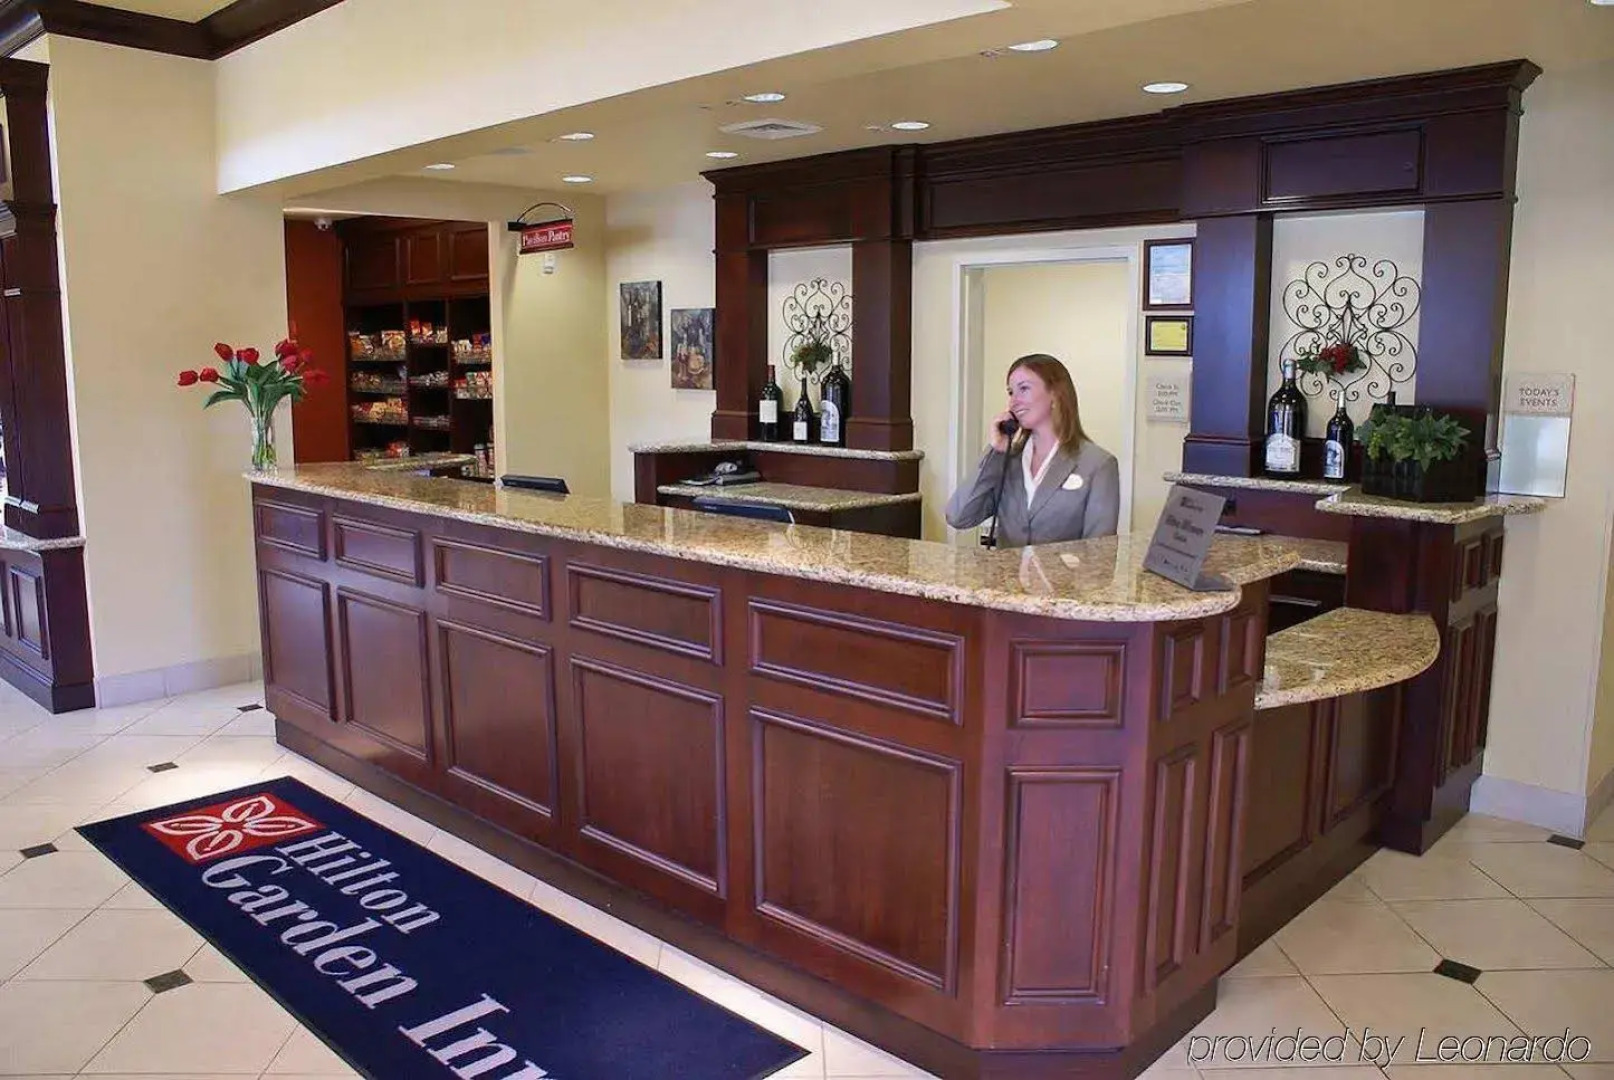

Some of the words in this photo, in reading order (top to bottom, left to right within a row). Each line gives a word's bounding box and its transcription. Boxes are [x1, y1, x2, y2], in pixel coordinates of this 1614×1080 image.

[1519, 387, 1559, 397] TODAY'S
[1519, 397, 1559, 407] EVENTS
[274, 831, 440, 934] Hilton
[202, 855, 419, 1009] Garden
[398, 993, 557, 1080] In
